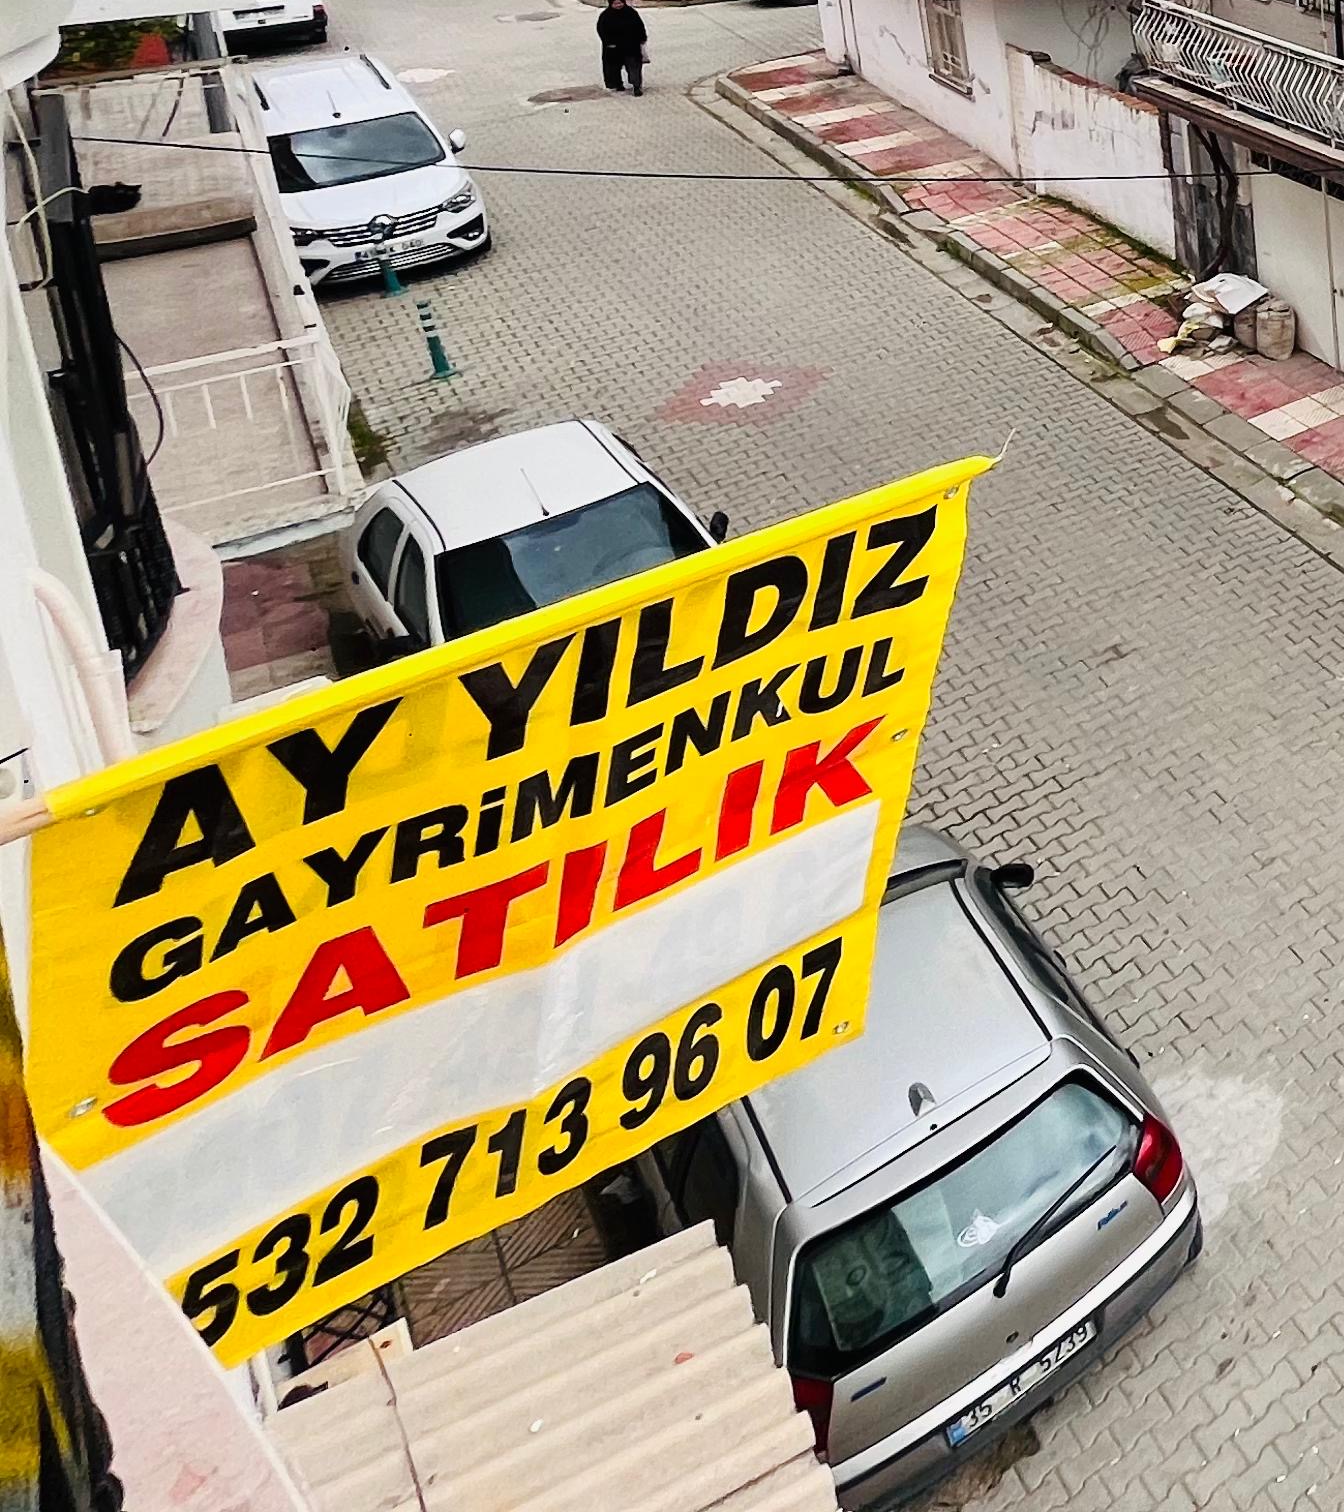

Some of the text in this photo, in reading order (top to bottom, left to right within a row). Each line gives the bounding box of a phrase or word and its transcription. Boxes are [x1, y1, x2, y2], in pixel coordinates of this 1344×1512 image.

[112, 504, 938, 909] AY YILDIZ
[102, 715, 886, 1127] SATILIK
[181, 936, 843, 1348] 532 713 96 07
[968, 1400, 992, 1427] 35
